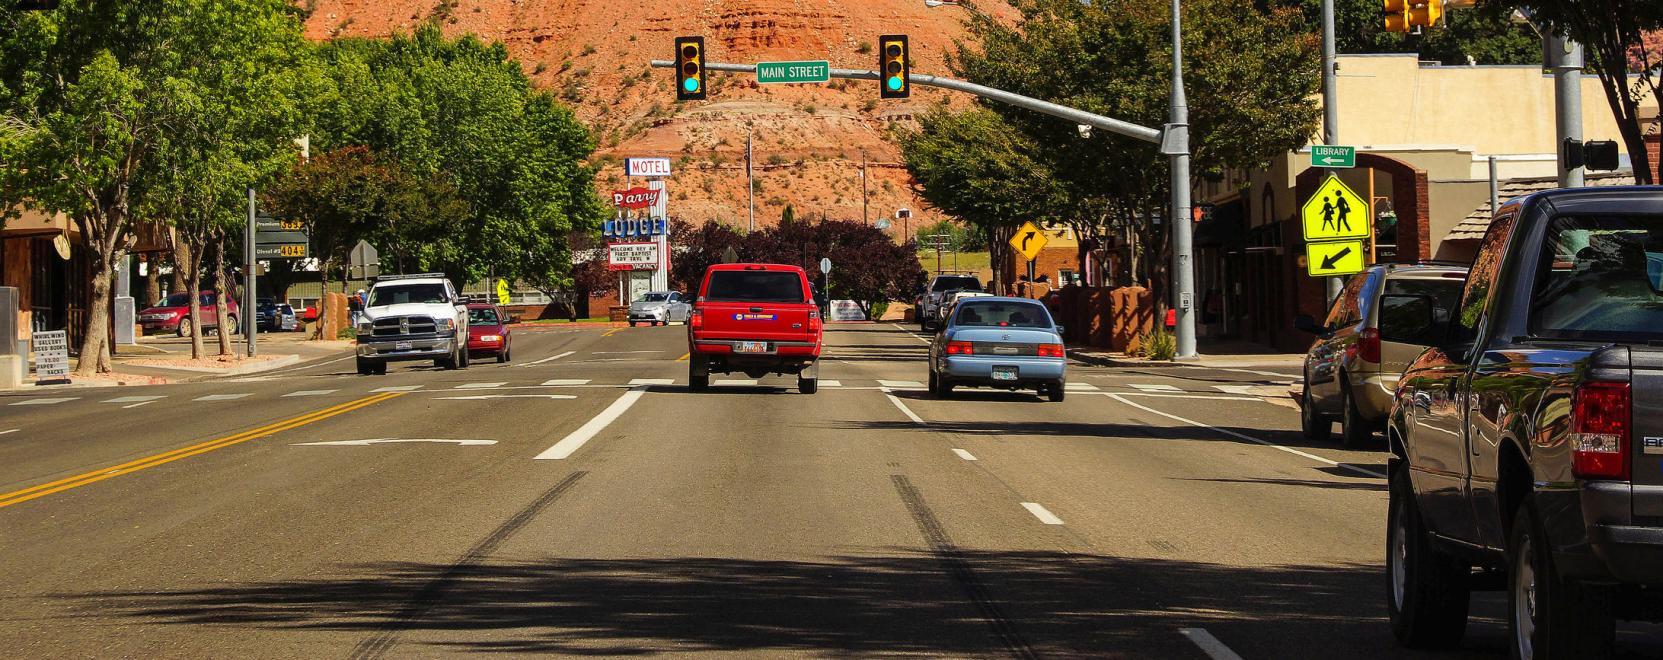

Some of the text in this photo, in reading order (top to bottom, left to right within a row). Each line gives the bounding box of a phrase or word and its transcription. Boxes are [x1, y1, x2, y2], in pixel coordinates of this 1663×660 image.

[761, 66, 825, 78] MAIN STREET
[1316, 147, 1350, 156] LIBRARY
[632, 160, 669, 174] MOTEL
[613, 192, 658, 206] Parry
[603, 216, 661, 236] LODGE
